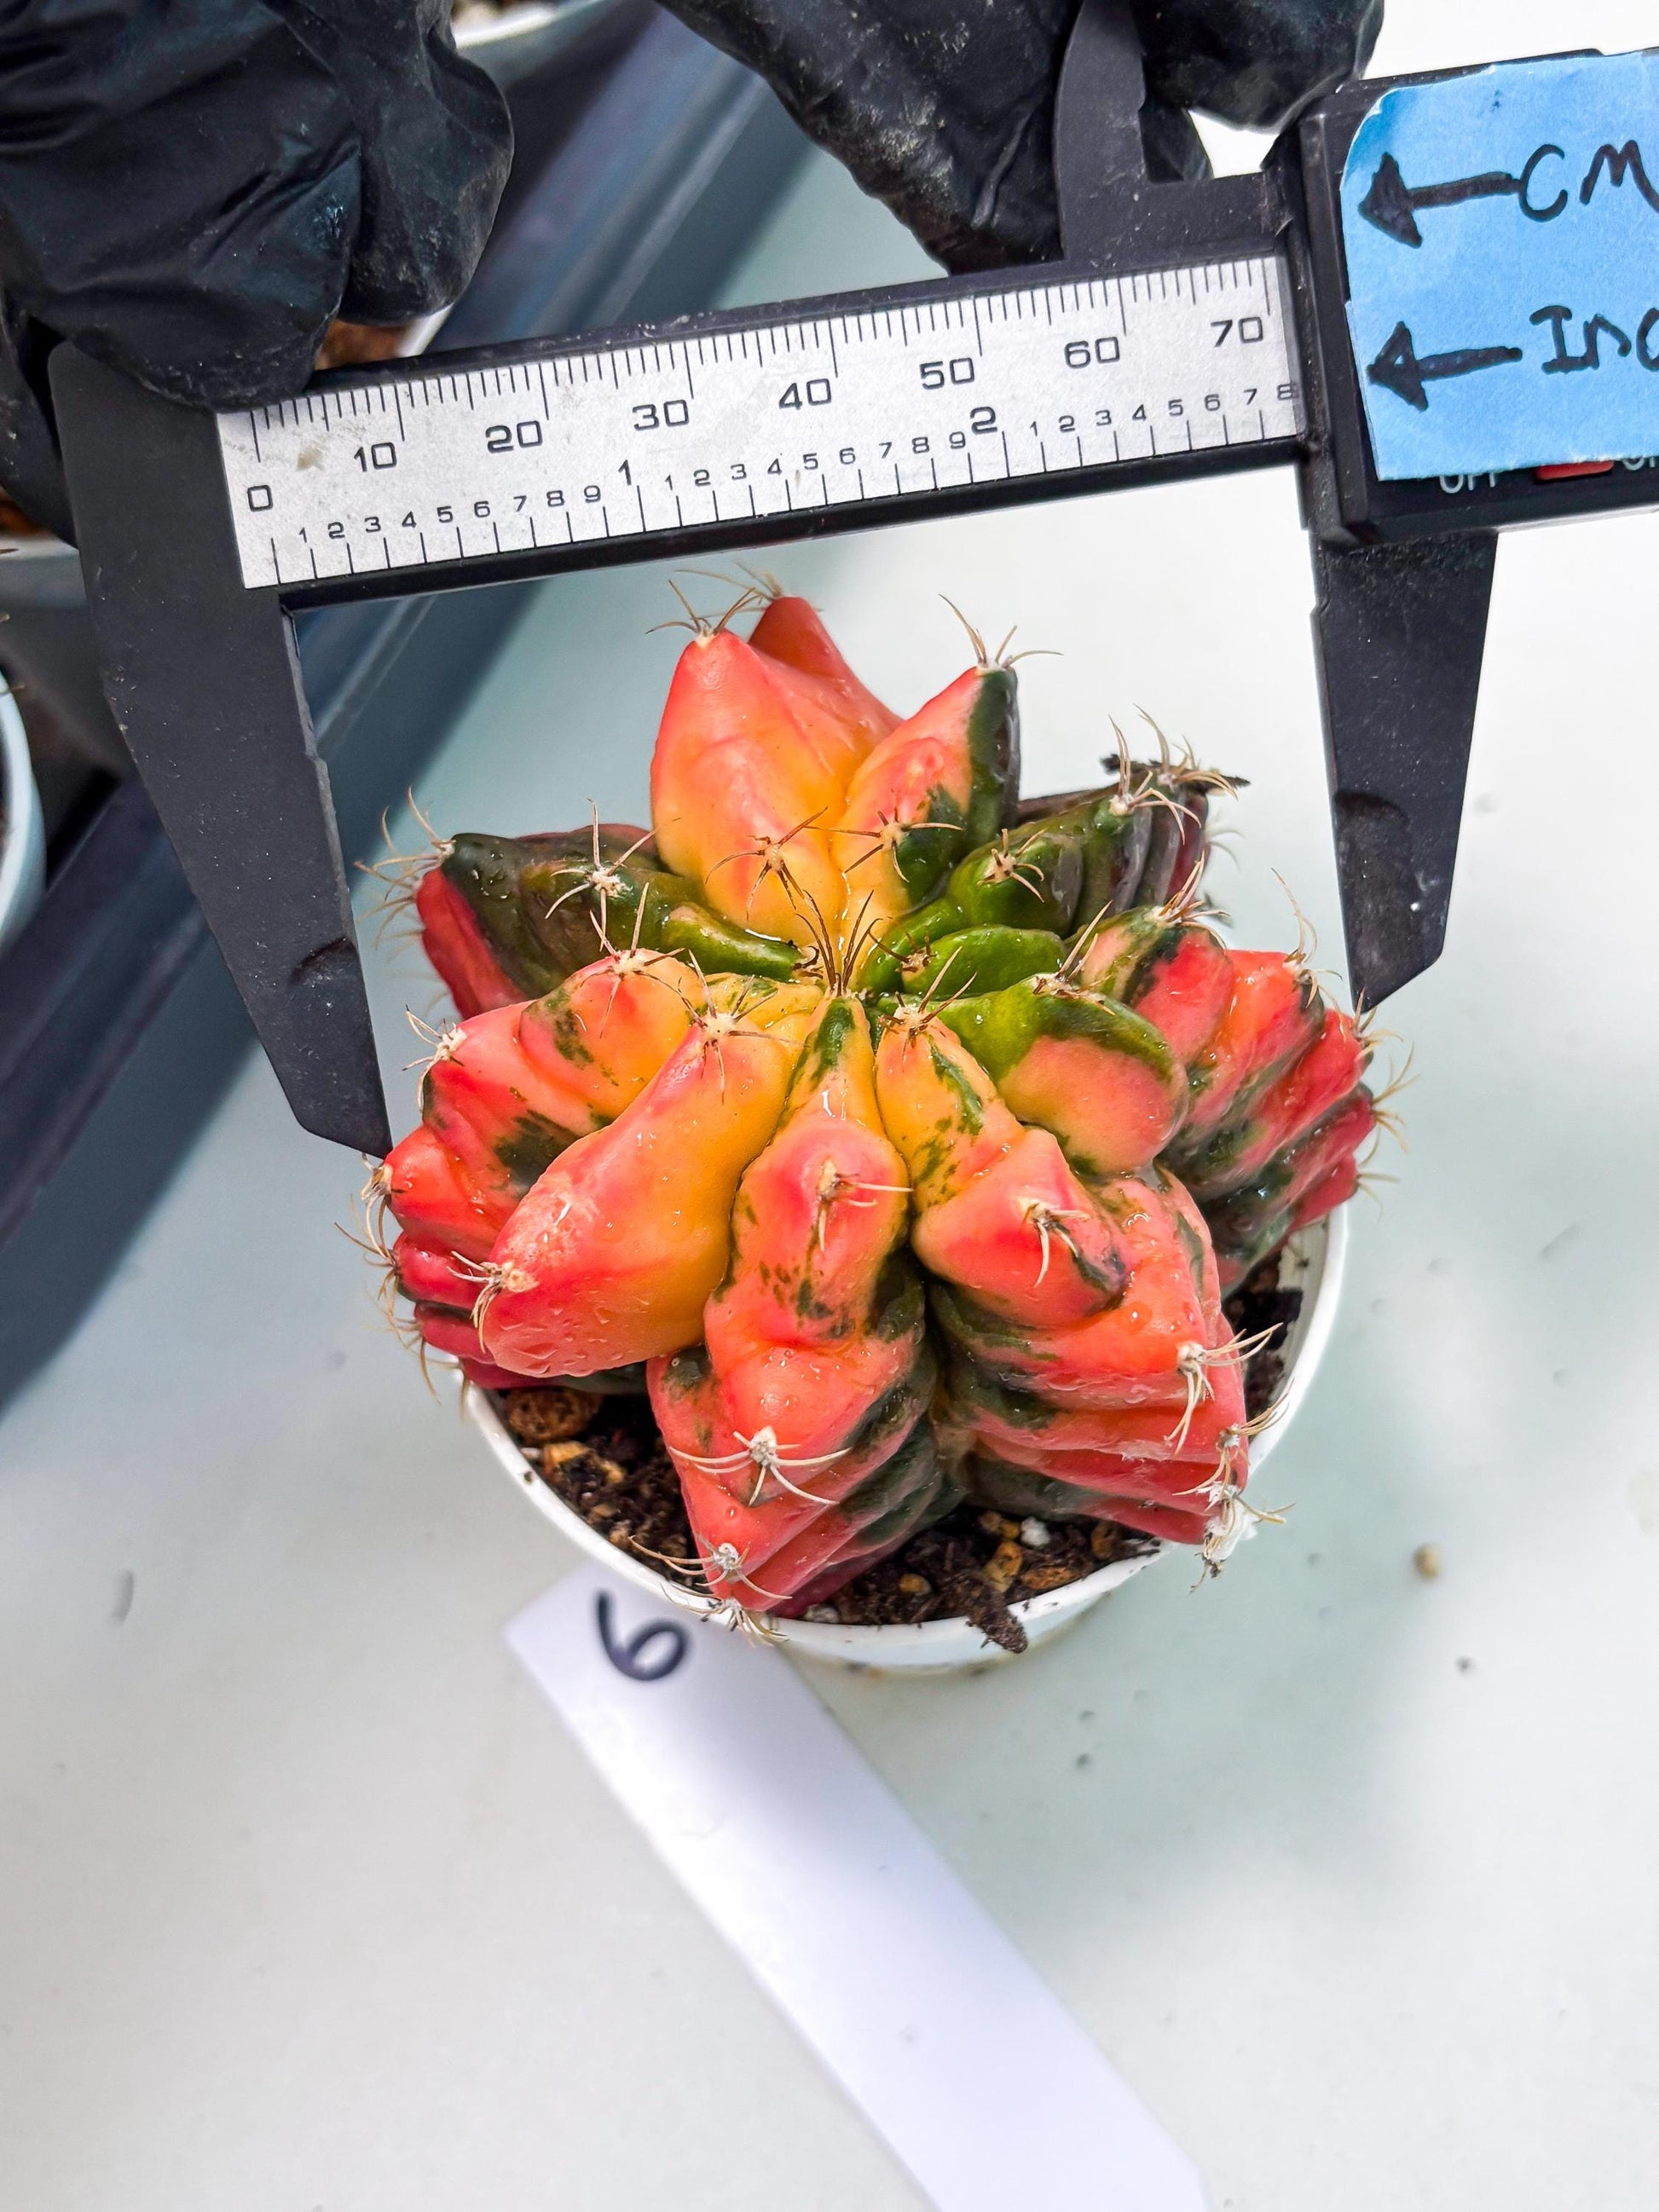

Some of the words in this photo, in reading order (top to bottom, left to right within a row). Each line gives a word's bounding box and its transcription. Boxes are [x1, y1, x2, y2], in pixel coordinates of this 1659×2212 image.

[1518, 140, 1659, 222] CM
[247, 484, 273, 512] 0
[353, 441, 398, 472] 10
[483, 419, 544, 454] 20
[630, 398, 691, 431] 30
[777, 377, 834, 411] 40
[918, 356, 976, 391] 50
[1063, 335, 1122, 370] 60
[1209, 315, 1265, 349] 70
[299, 528, 309, 542] 1
[327, 522, 345, 540] 2
[365, 516, 382, 533] 3
[401, 511, 418, 528] 4
[437, 505, 454, 523] 5
[474, 500, 491, 518] 6
[512, 494, 531, 513] 7
[546, 489, 566, 508] 8
[583, 484, 602, 503] 9
[618, 459, 633, 486] 1
[664, 475, 673, 491] 1
[693, 469, 711, 486] 2
[731, 463, 748, 480] 3
[767, 458, 783, 476] 4
[803, 453, 819, 471] 5
[840, 447, 857, 465] 6
[878, 442, 893, 459] 7
[912, 436, 930, 454] 8
[949, 430, 966, 449] 9
[969, 406, 999, 435] 2
[1029, 420, 1039, 437] 1
[1058, 415, 1076, 433] 2
[1095, 409, 1113, 426] 3
[1131, 404, 1147, 423] 4
[1168, 399, 1184, 417] 5
[1204, 394, 1221, 412] 6
[1243, 388, 1257, 406] 7
[594, 1589, 690, 1681] 6
